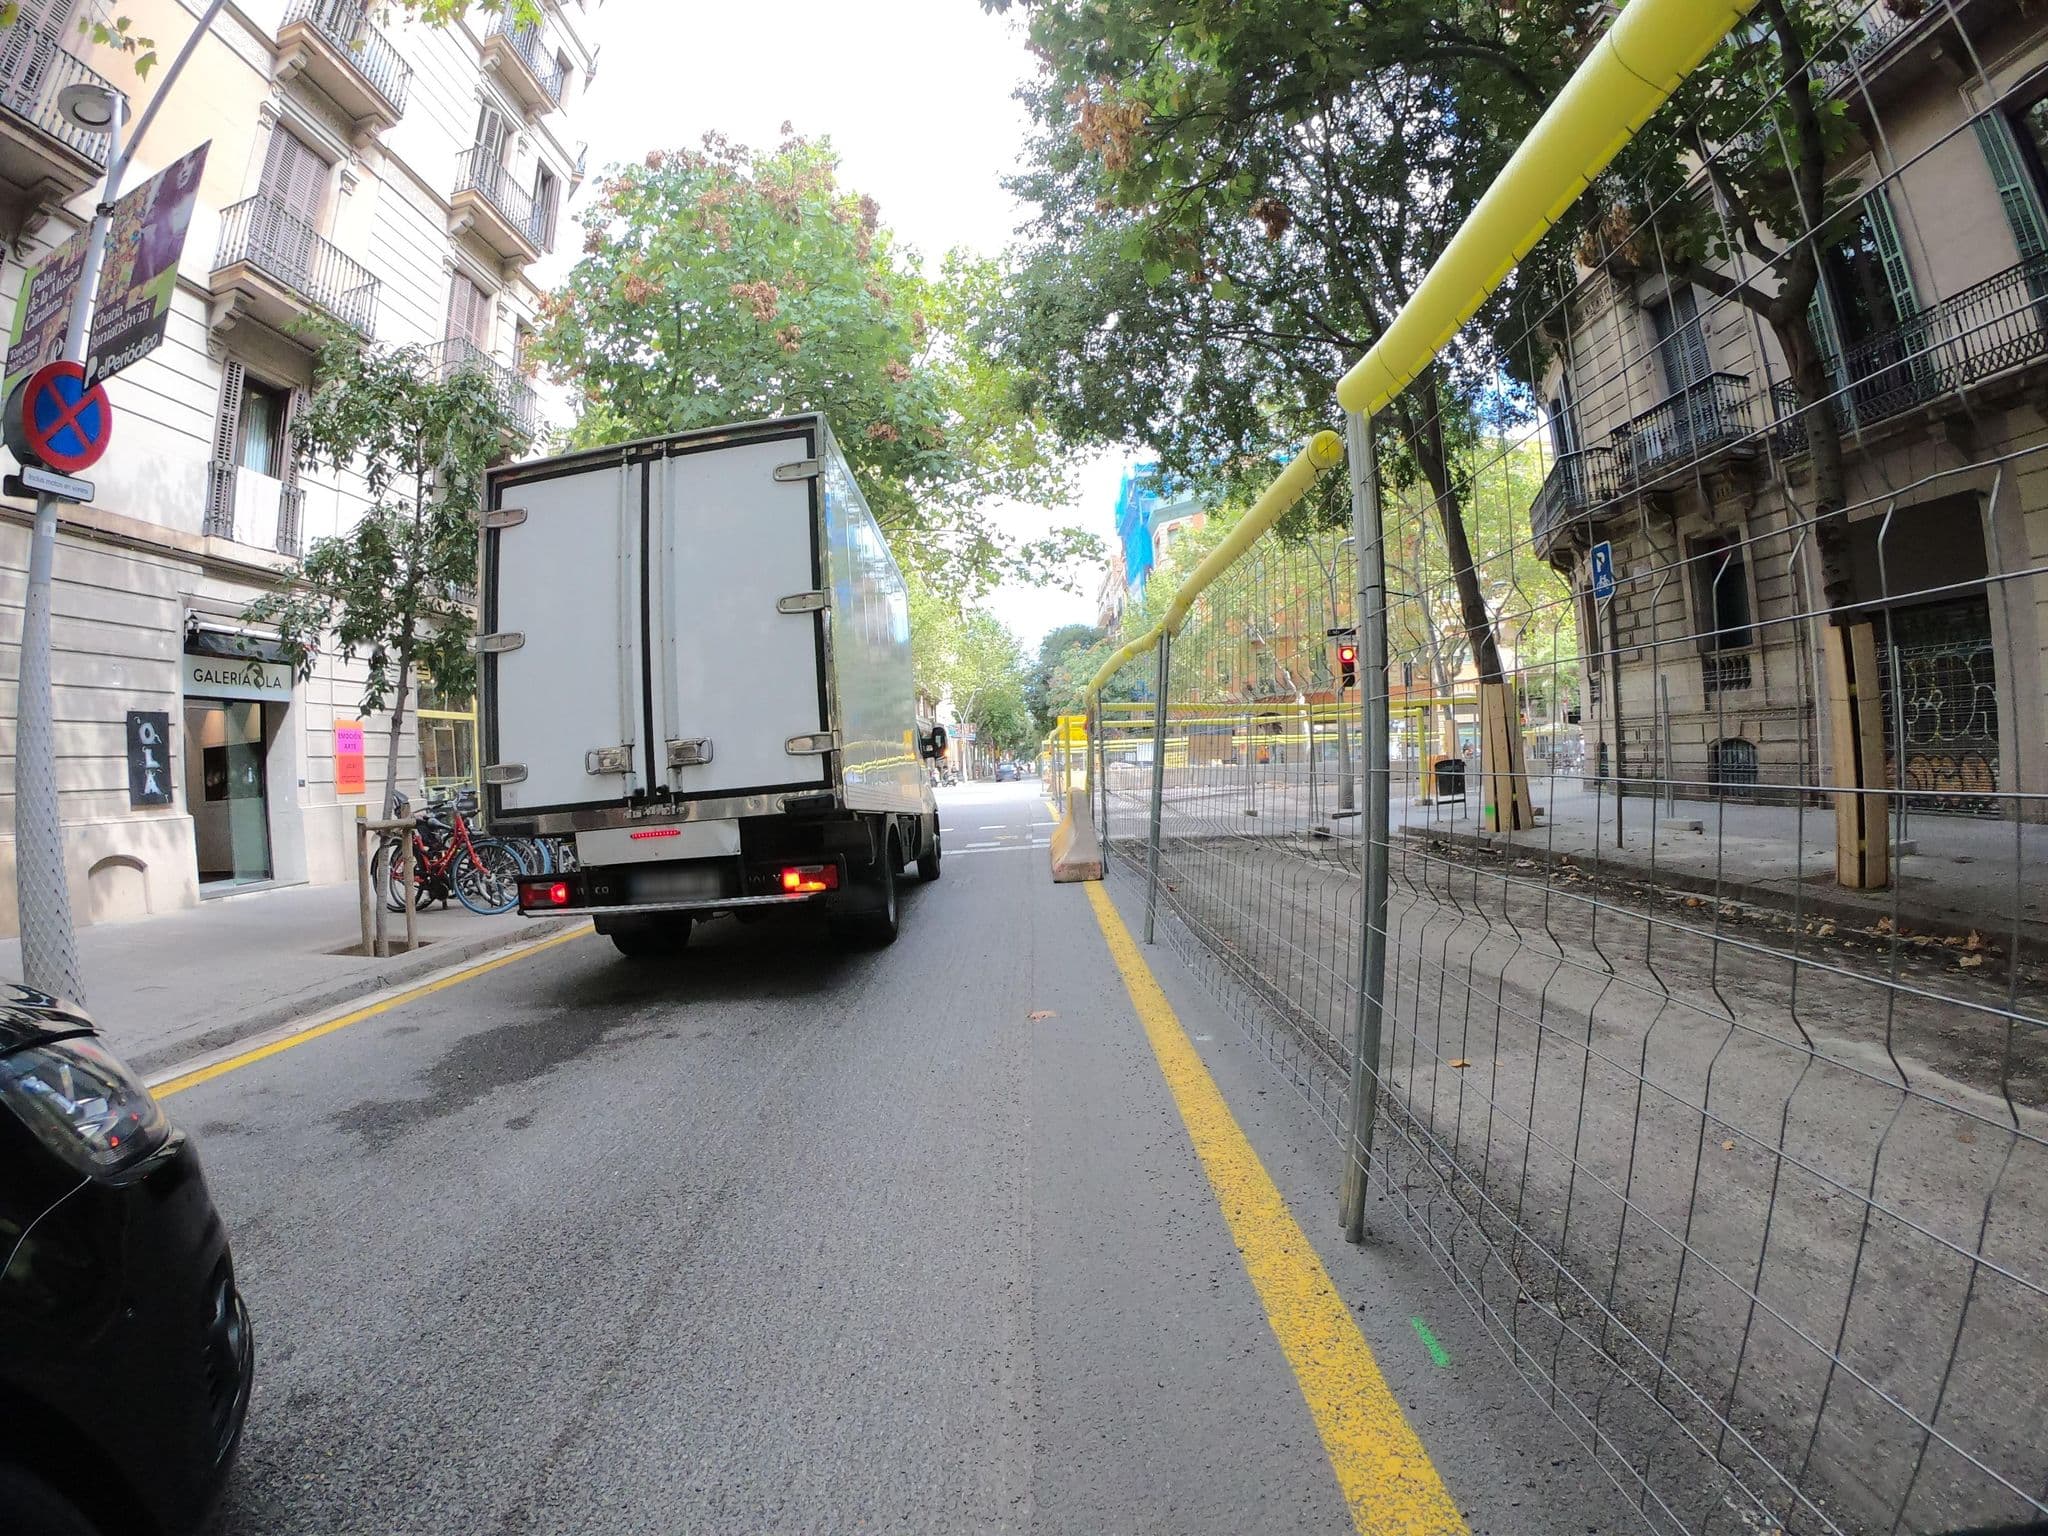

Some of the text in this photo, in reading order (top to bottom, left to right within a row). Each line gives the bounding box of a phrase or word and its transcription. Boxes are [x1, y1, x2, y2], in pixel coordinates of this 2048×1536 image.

[31, 270, 56, 296] Palau
[25, 296, 63, 331] Catalana
[28, 297, 40, 315] de
[38, 290, 49, 306] la
[92, 303, 123, 333] Khatia
[97, 332, 159, 380] elPeriódico
[1596, 551, 1606, 573] P
[193, 668, 282, 689] GALERIA OLA
